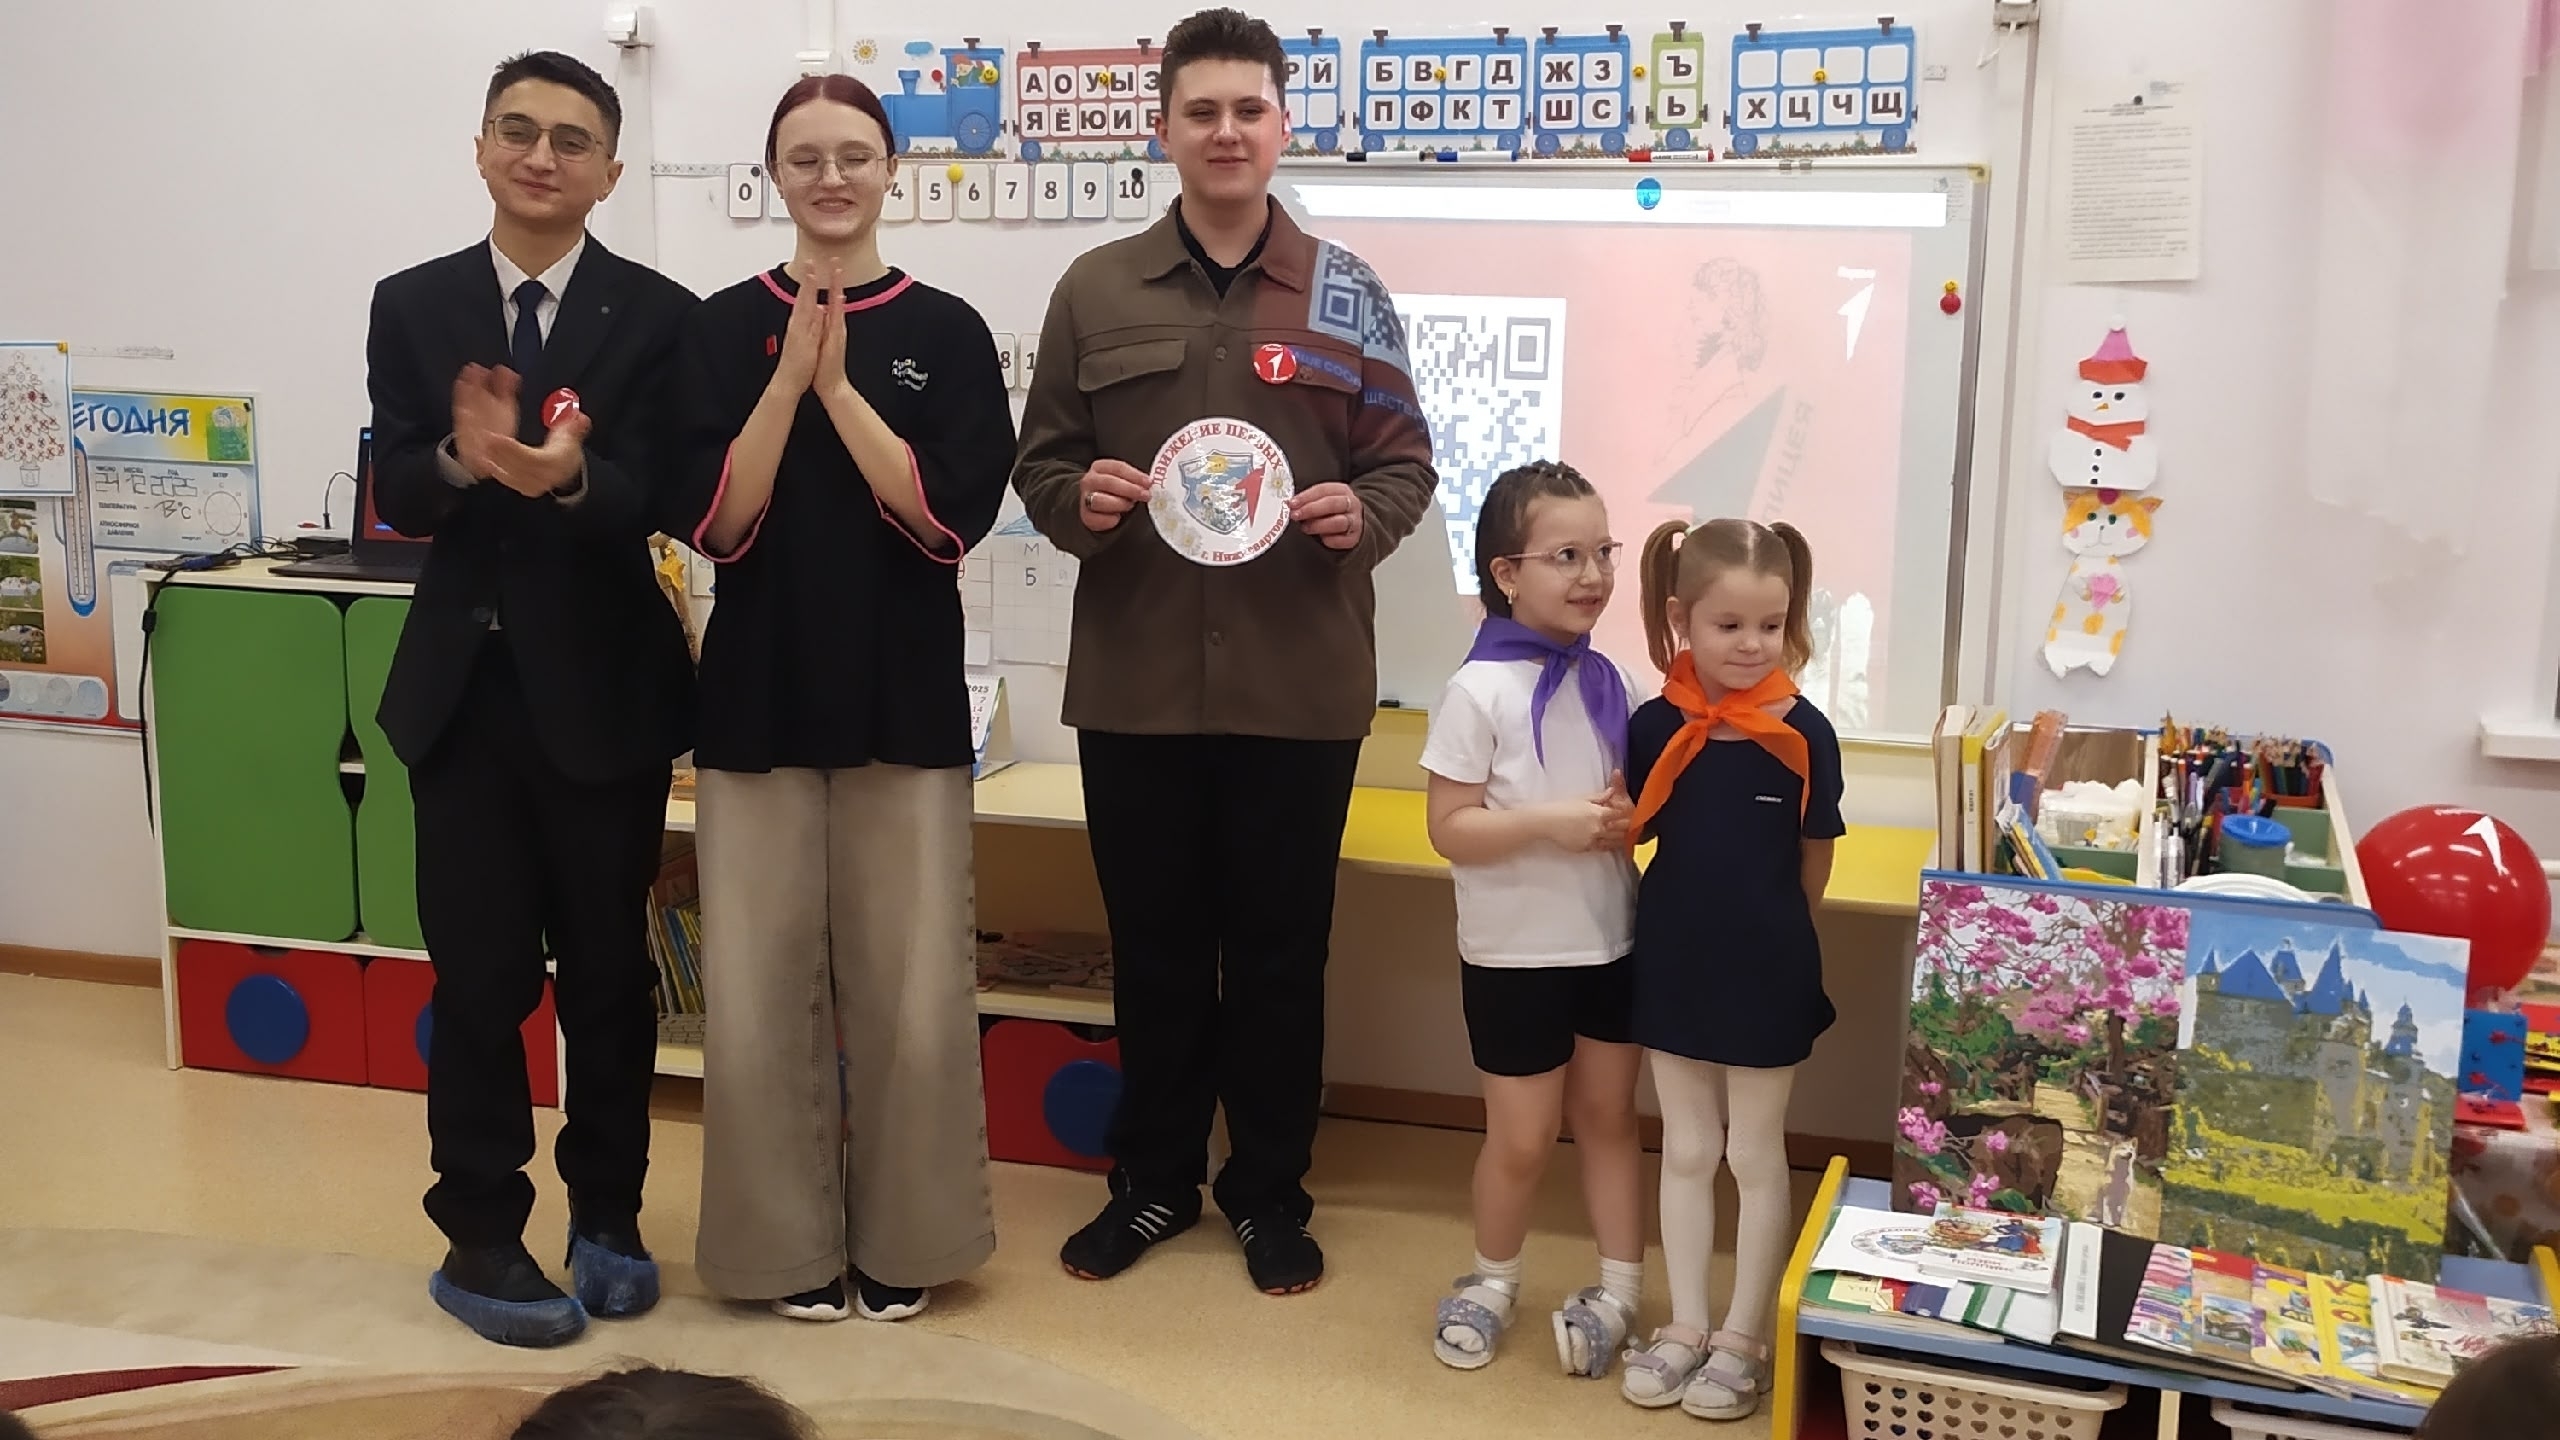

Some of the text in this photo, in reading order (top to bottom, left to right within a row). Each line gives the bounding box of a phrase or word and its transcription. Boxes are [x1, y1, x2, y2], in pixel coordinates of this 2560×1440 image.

[1286, 58, 1332, 83] Р Й
[1376, 60, 1514, 84] Б В Г Д
[1545, 60, 1611, 83] Ж З
[1666, 56, 1692, 77] Ъ
[1026, 71, 1161, 94] А О У Ы Э
[1375, 100, 1510, 121] П Ф К Т
[1546, 99, 1611, 121] Ш С
[1667, 96, 1686, 116] Ь
[1747, 92, 1902, 121] Х Ц Ч Щ
[1027, 112, 1042, 130] Я
[1056, 108, 1070, 131] Ё
[1081, 110, 1106, 130] Ю
[1114, 109, 1131, 129] И
[738, 180, 1144, 201] 0 4 5 6 7 8 9 10
[1000, 351, 1011, 369] 8
[73, 402, 189, 436] ЕГОДНЯ
[1025, 567, 1037, 586] Б
